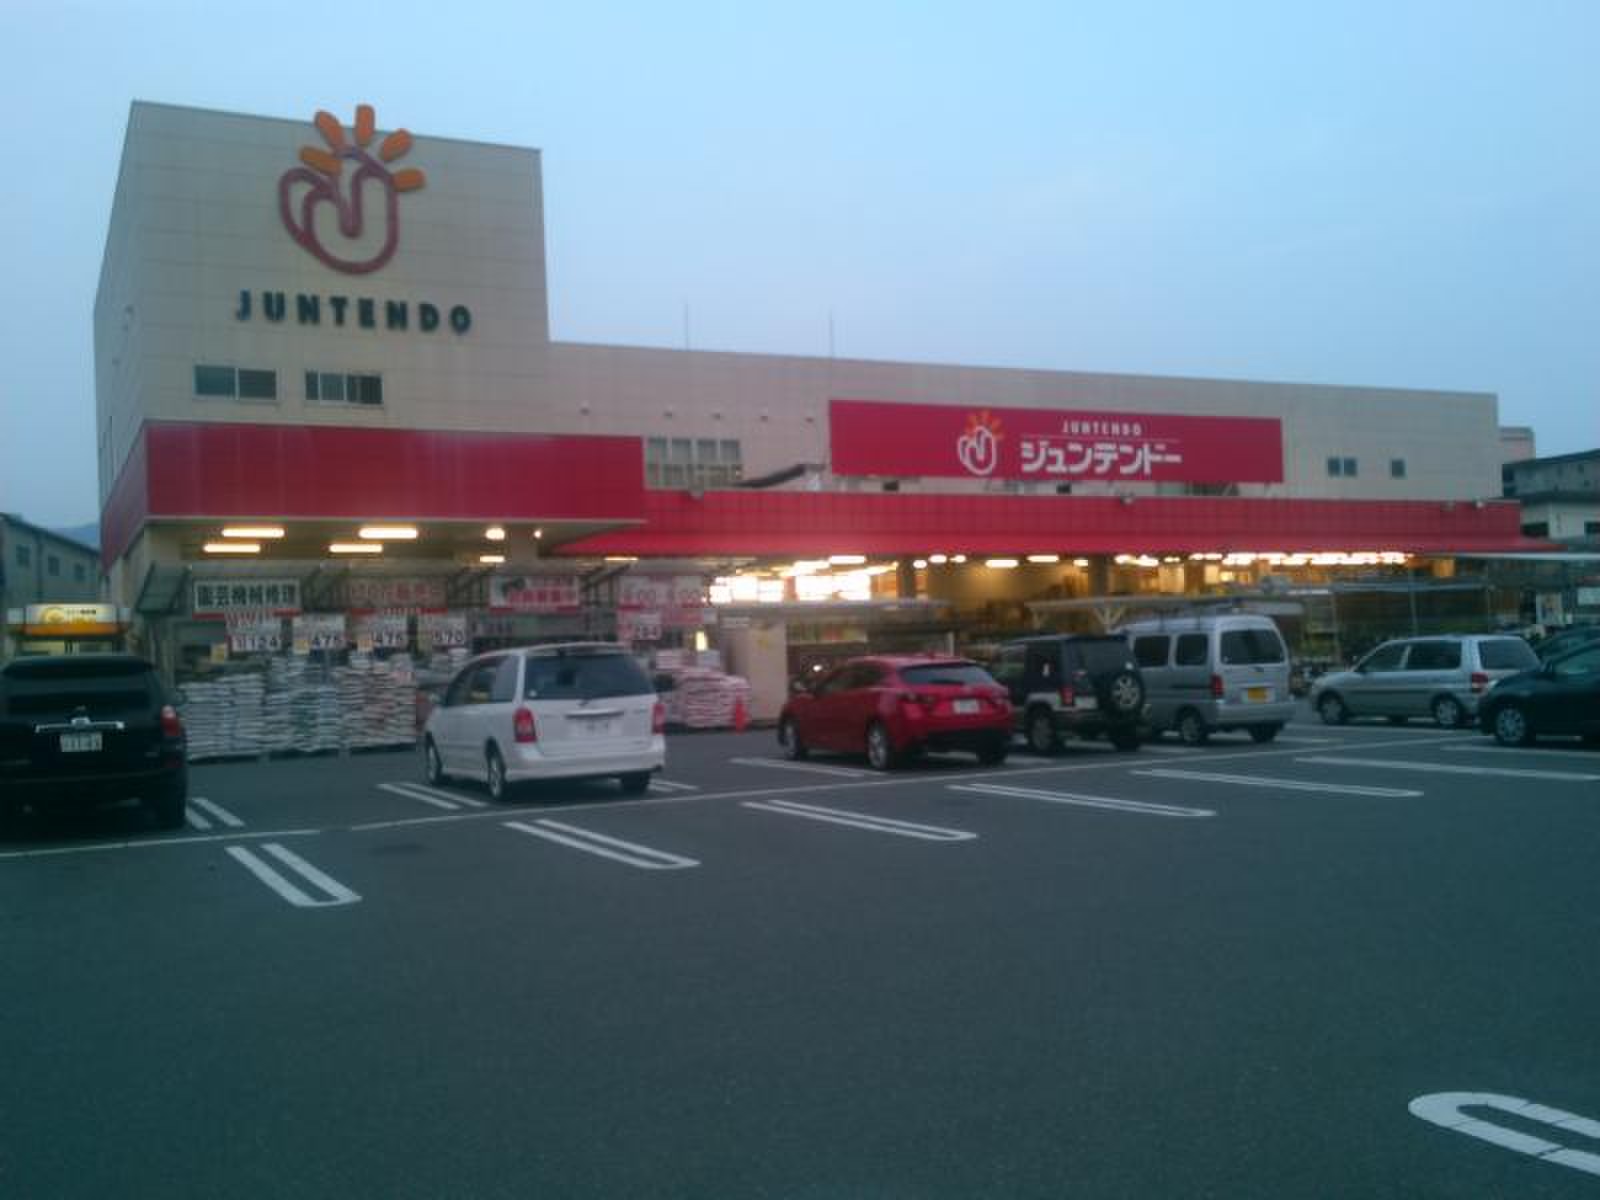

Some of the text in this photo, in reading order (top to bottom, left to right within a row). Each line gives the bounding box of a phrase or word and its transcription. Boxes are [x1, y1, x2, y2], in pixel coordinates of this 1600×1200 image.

[235, 288, 472, 334] JUNTENDO
[1061, 420, 1143, 437] JUNTENDO
[1020, 440, 1183, 475] ジュンテンドー
